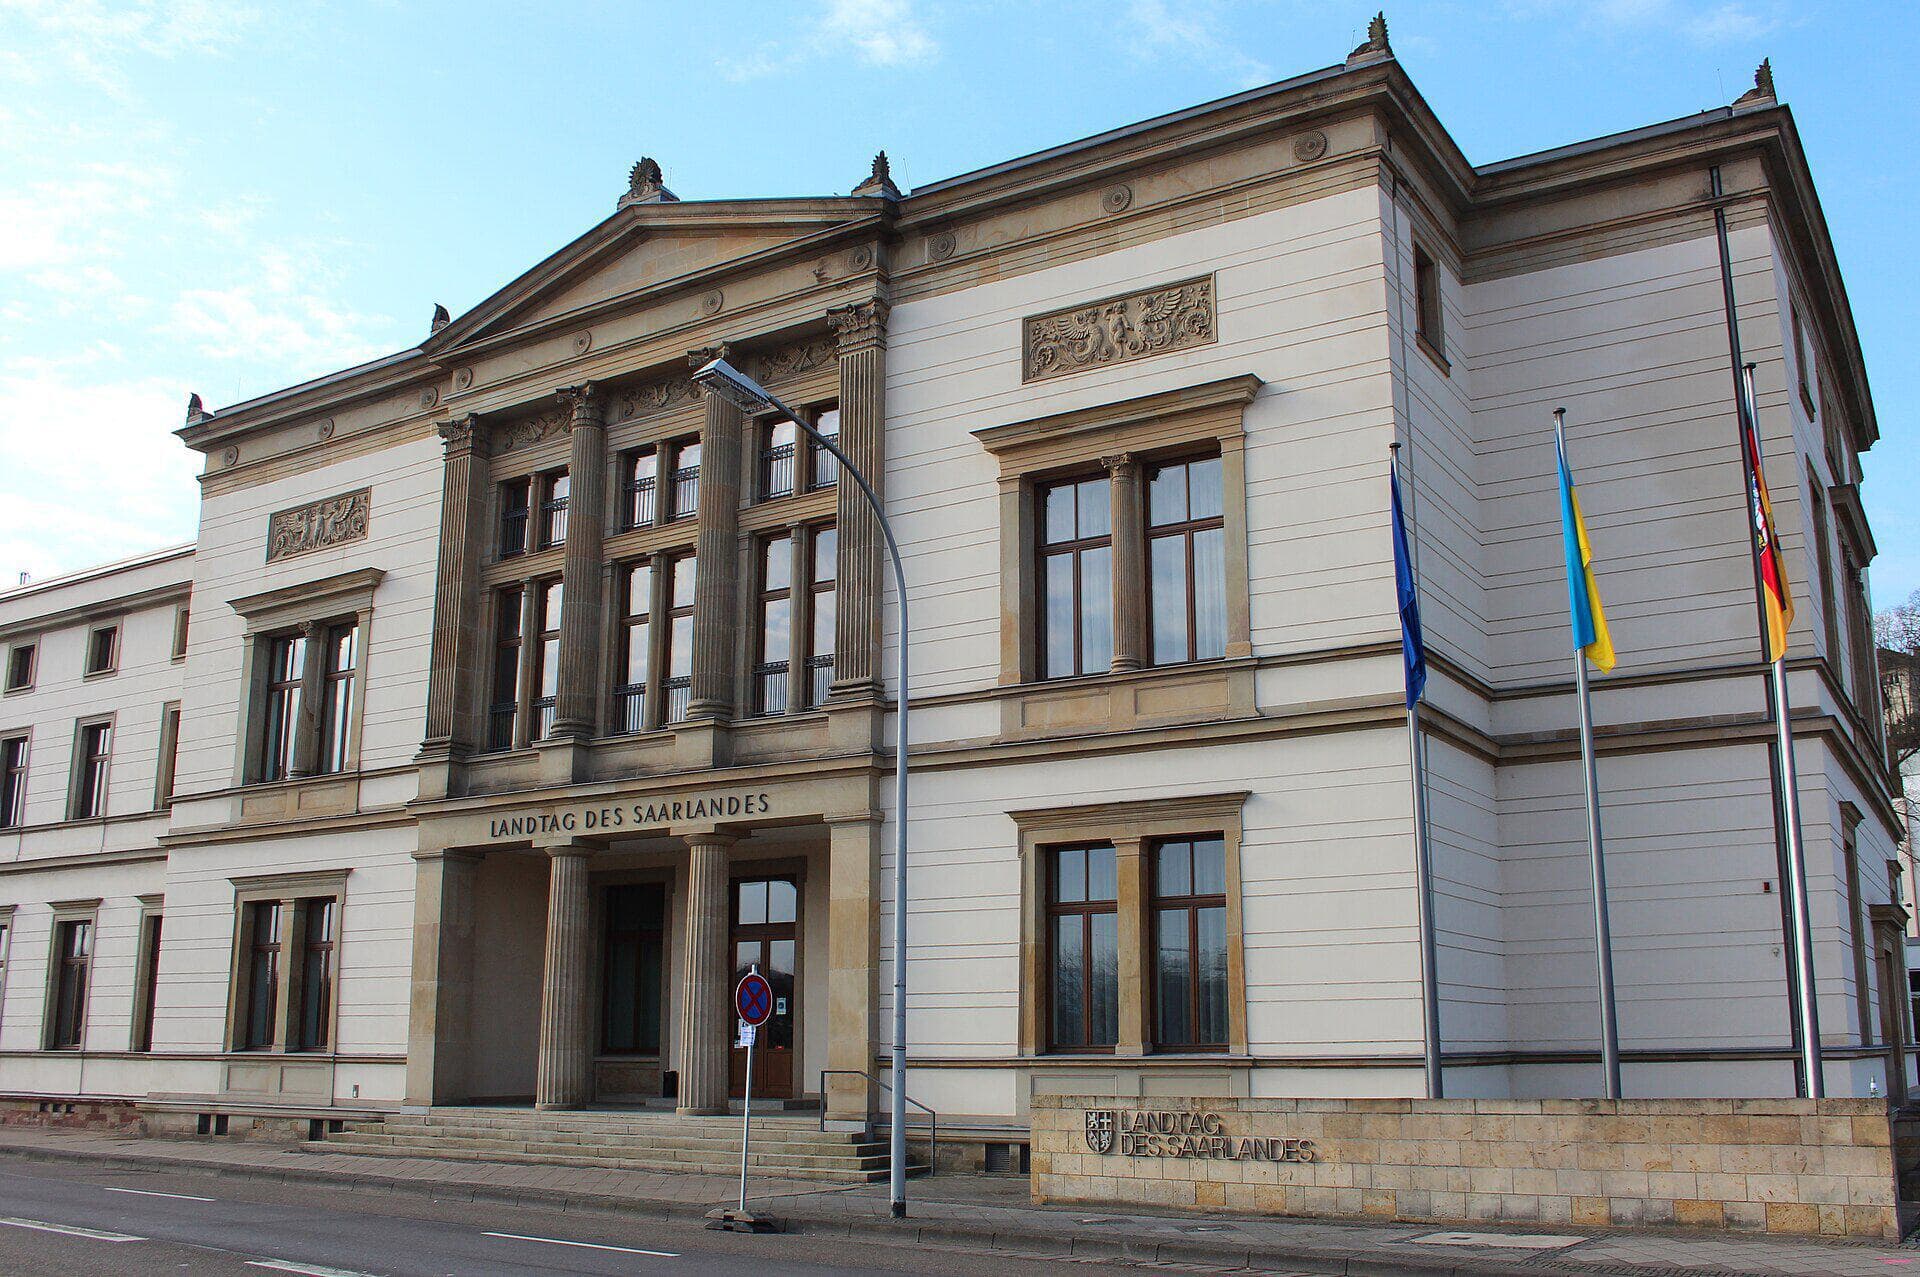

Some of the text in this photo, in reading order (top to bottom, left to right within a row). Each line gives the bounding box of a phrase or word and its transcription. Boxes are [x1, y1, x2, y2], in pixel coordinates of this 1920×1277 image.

[490, 793, 770, 838] LANDTAG DES SAARLANDES
[1120, 1110, 1221, 1135] LANDTAG
[1121, 1134, 1315, 1163] DES SAARLANDES
